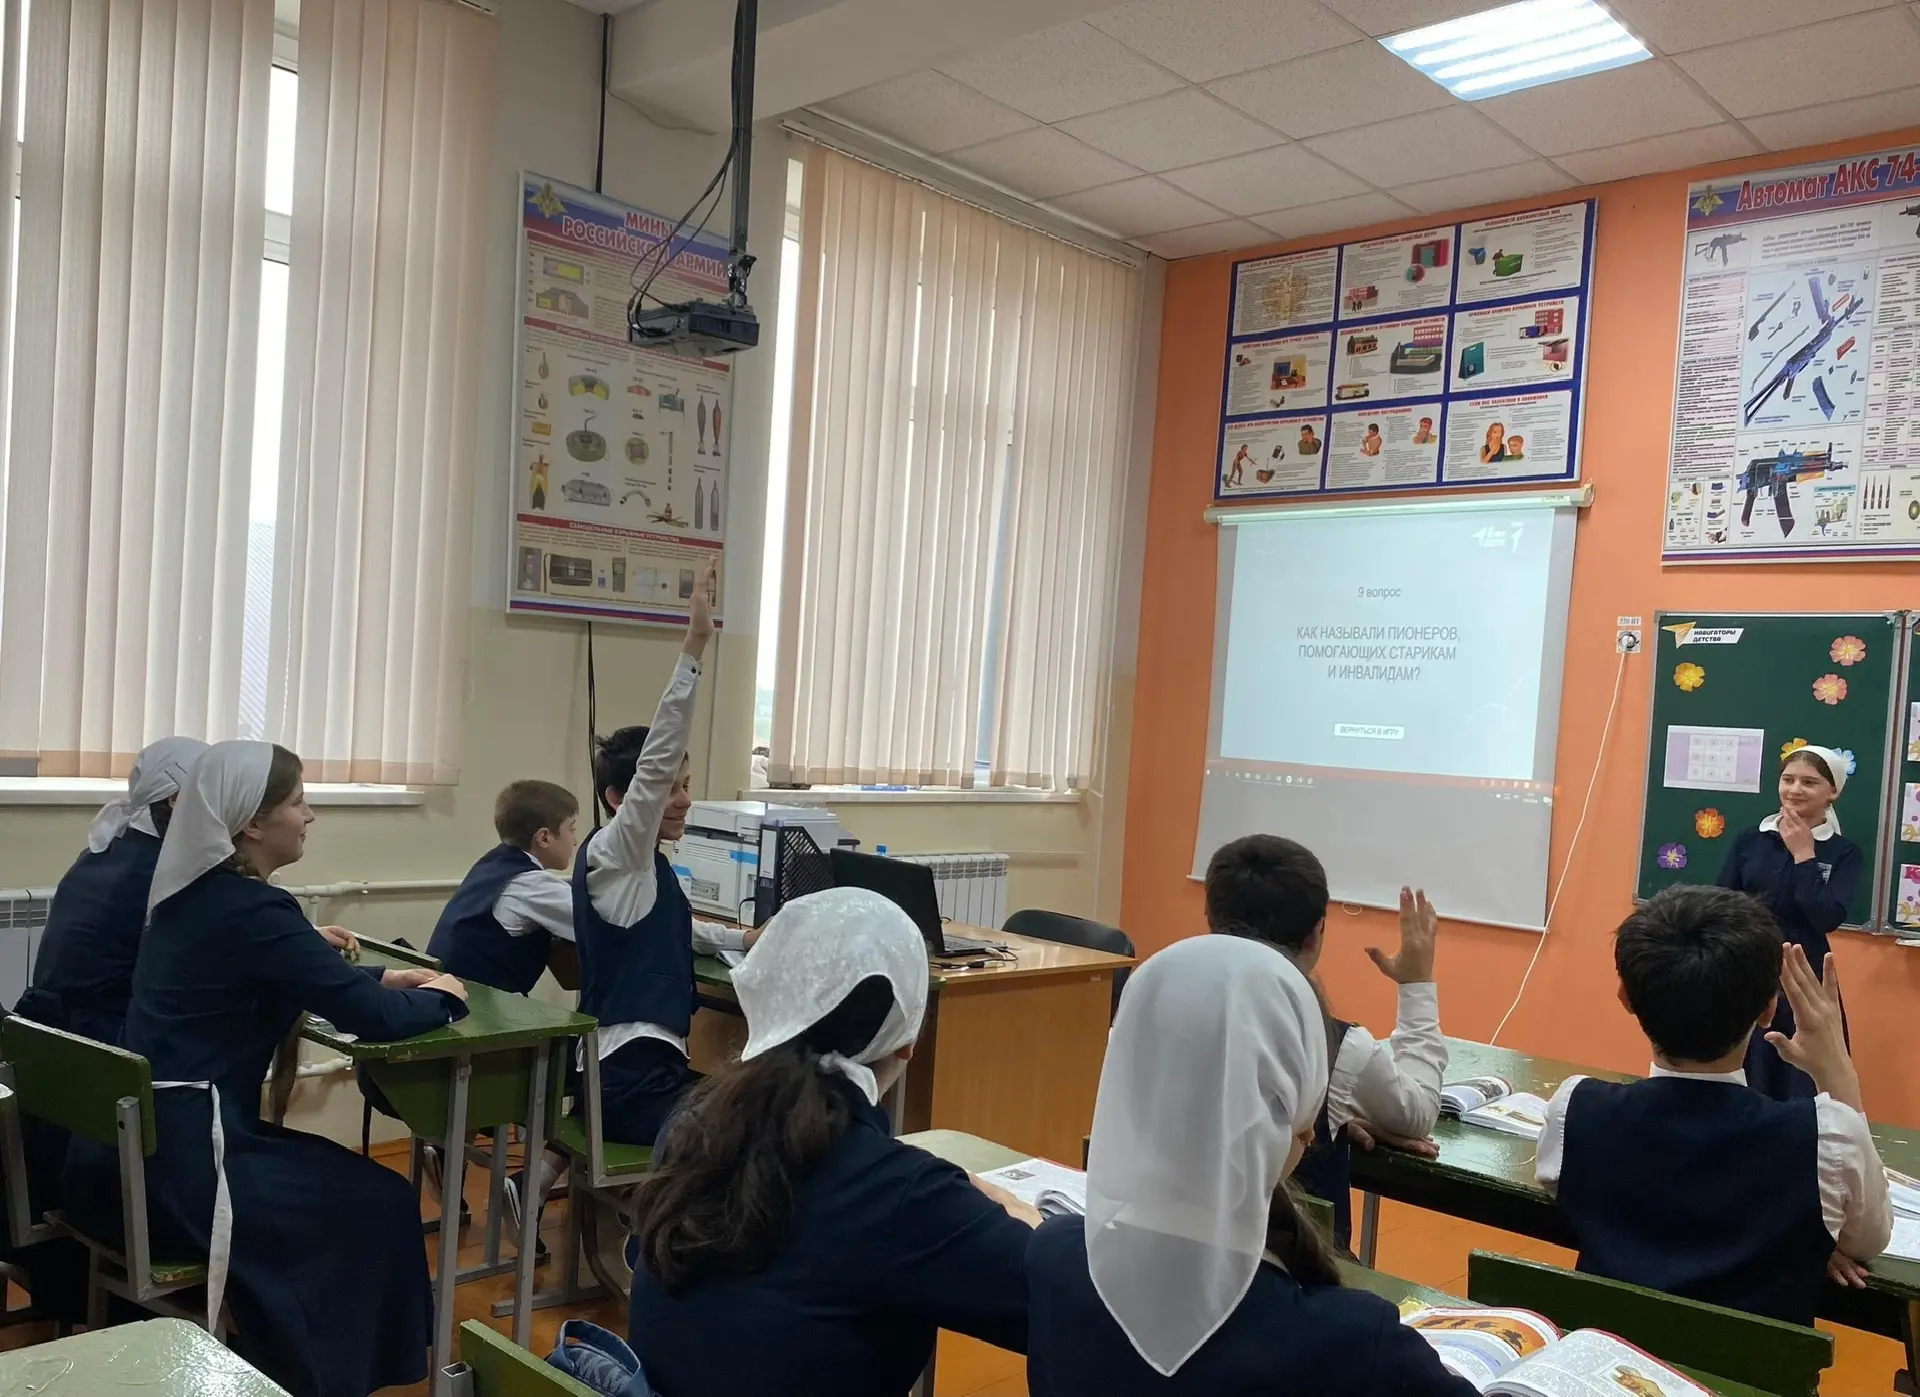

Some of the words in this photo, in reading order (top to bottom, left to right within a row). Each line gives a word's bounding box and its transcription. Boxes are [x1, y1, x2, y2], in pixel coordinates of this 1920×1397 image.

[1736, 175, 1830, 212] Автомат
[1831, 157, 1880, 197] АКС
[624, 211, 675, 241] МИНЫ
[562, 215, 670, 264] РОССИЙСКОЙ
[1358, 586, 1364, 598] 9
[1366, 588, 1402, 600] вопрос
[1296, 626, 1318, 639] КАК
[1320, 626, 1385, 640] НАЗЫВАЛИ
[1388, 626, 1461, 642] ПИОНЕРОВ,
[1298, 645, 1387, 661] ПОМОГАЮЩИХ
[1389, 646, 1457, 660] СТАРИКАМ
[1328, 665, 1337, 679] И
[1339, 665, 1421, 682] ИНВАЛИДАМ?
